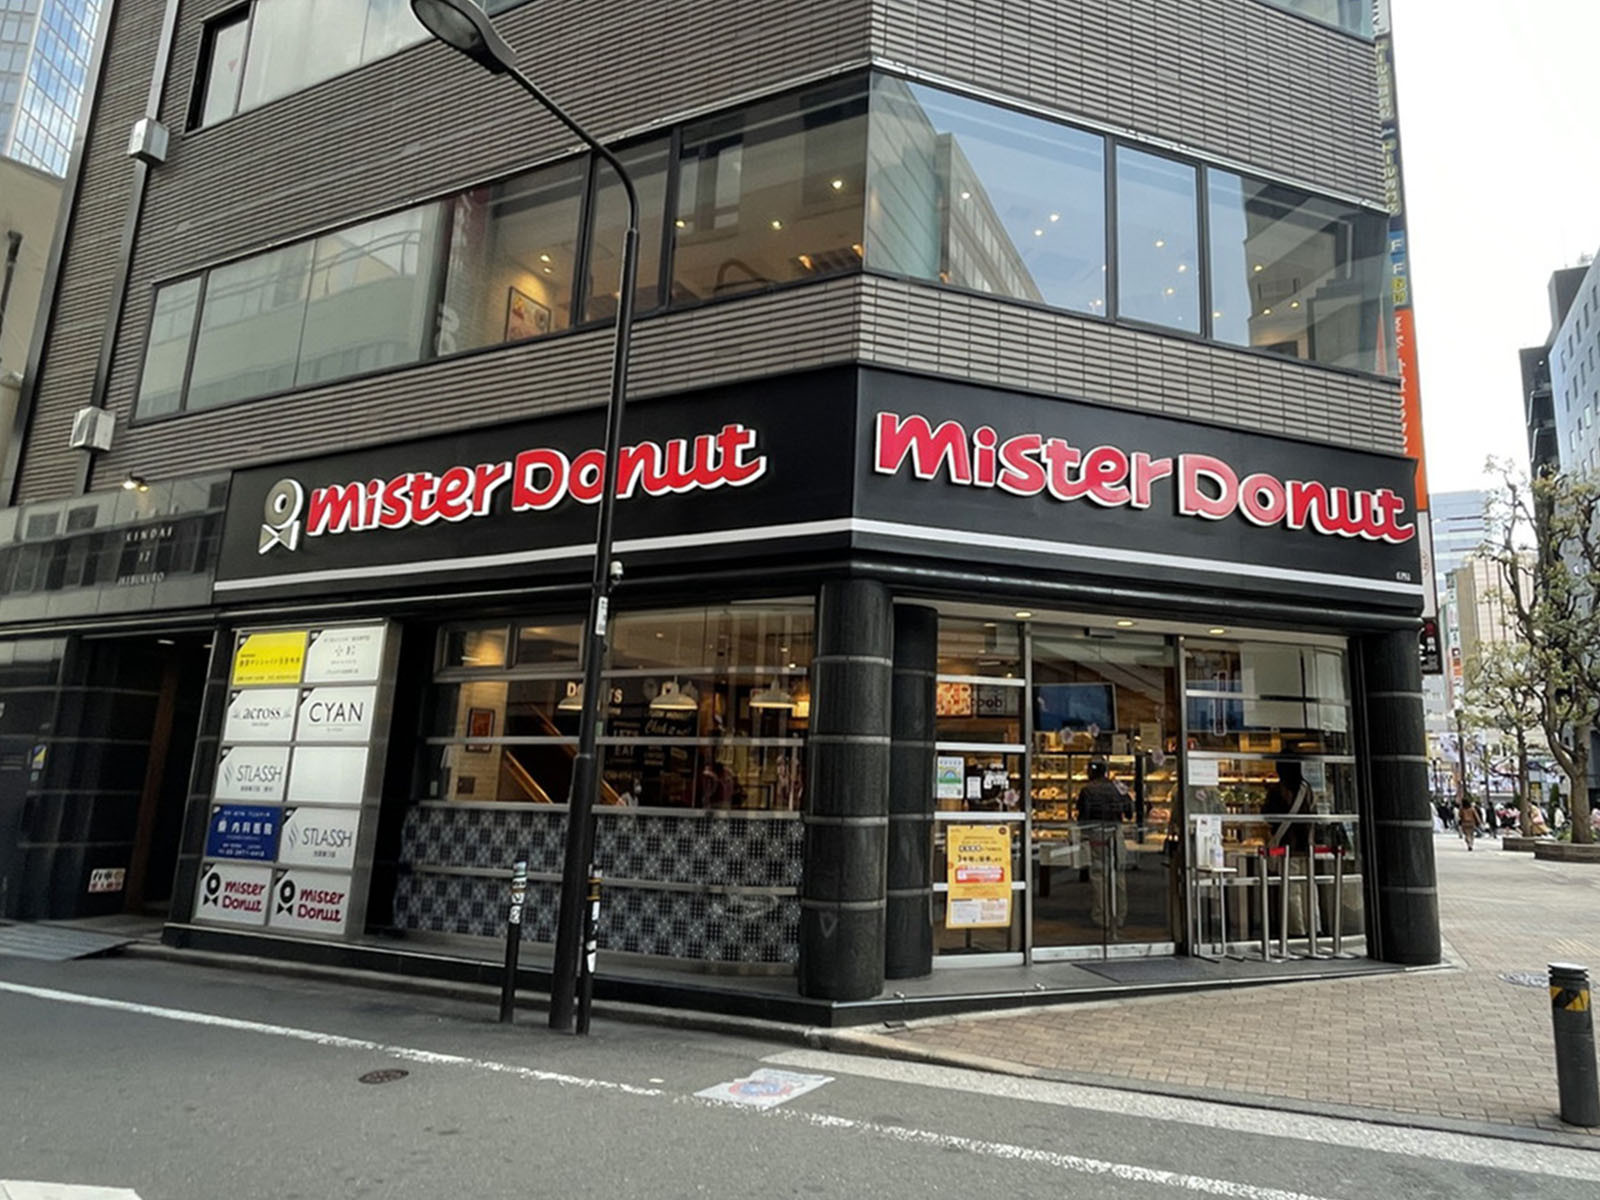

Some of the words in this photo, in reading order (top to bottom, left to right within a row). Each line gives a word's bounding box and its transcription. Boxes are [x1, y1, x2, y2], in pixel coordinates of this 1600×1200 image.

[511, 423, 767, 511] Donut
[1178, 454, 1416, 543] Donut
[242, 707, 281, 720] across
[308, 702, 364, 723] CYAN
[236, 764, 283, 783] STLASSH
[301, 827, 354, 849] STLASSH
[222, 895, 263, 913] Donut
[297, 903, 343, 923] Donut
